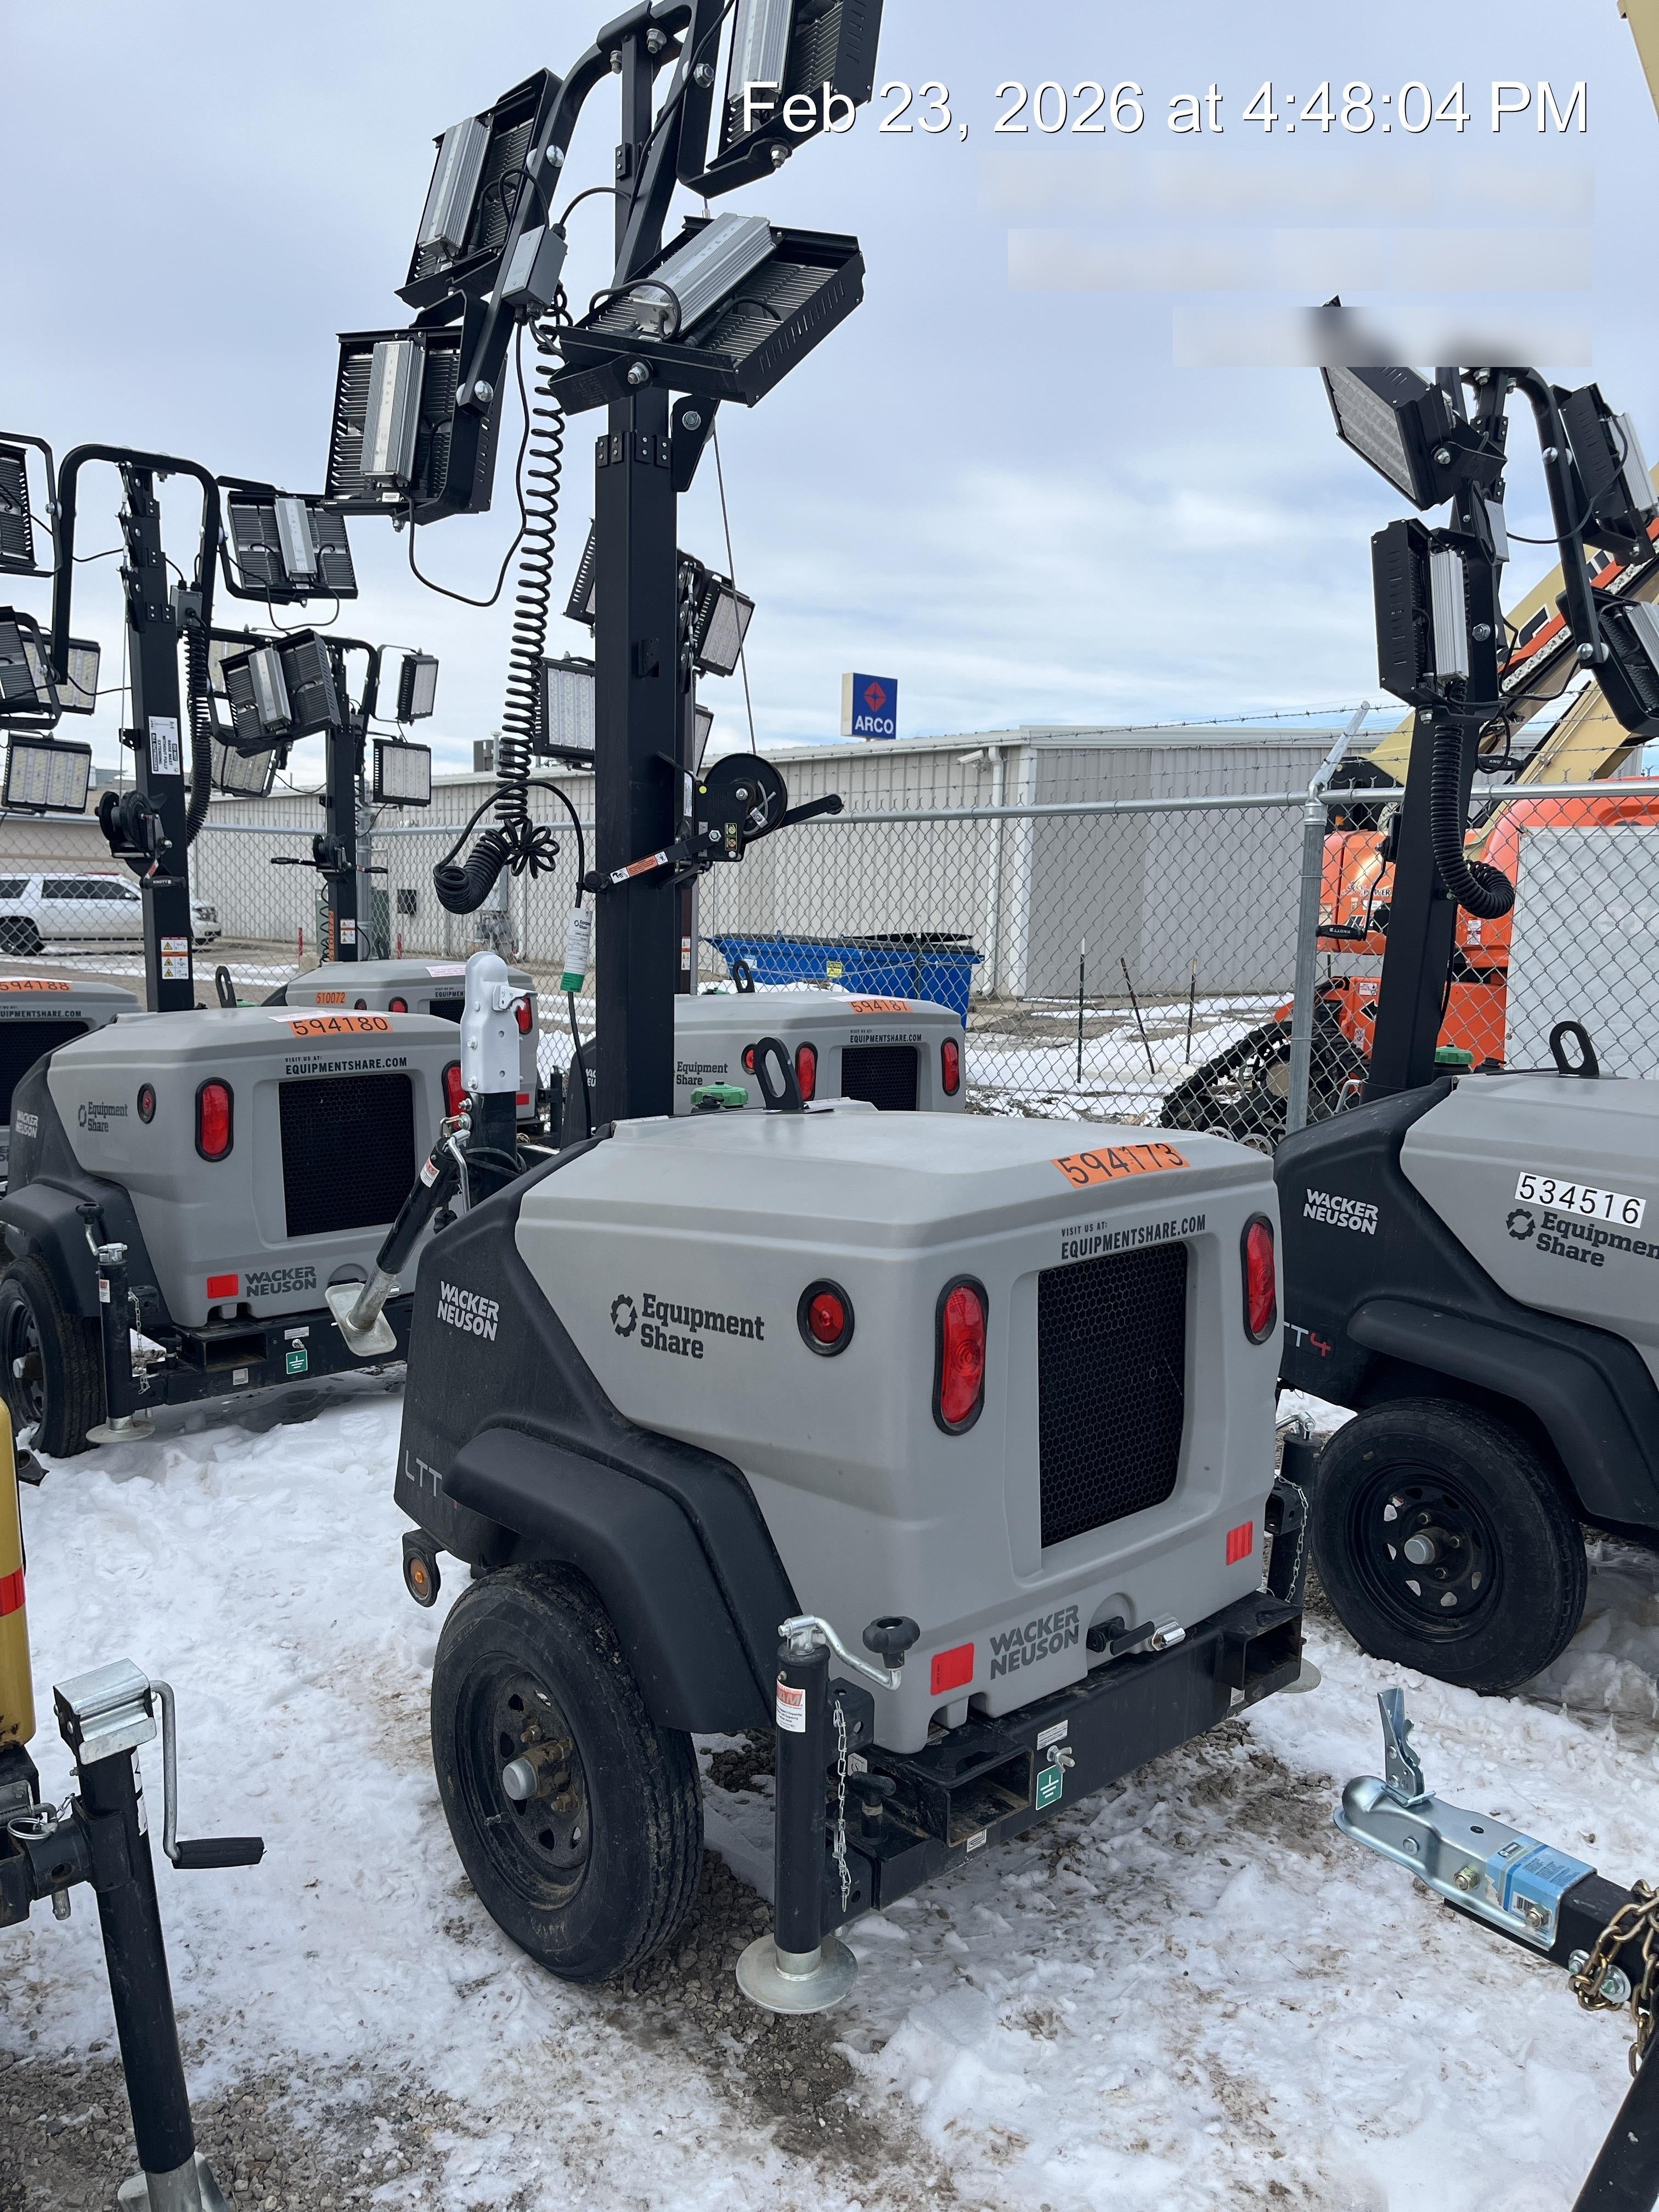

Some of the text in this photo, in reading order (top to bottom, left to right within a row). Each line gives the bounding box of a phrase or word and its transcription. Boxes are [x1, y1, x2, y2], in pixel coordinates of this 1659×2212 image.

[855, 715, 894, 734] ARCO
[0, 981, 70, 991] 594188
[317, 993, 346, 1004] 510072
[851, 1000, 907, 1013] 594187
[294, 1017, 388, 1036] 594180
[850, 1034, 922, 1043] EQUIPMENTSHARE.COM
[286, 1057, 407, 1075] EQUIPMENTSHARE.COM
[676, 1061, 728, 1075] Equipment
[676, 1075, 703, 1085] Share
[88, 1102, 128, 1119] Equipment
[88, 1119, 109, 1132] Share
[1057, 1143, 1183, 1184] 594173
[1306, 1188, 1379, 1221] WACKER
[1519, 1175, 1640, 1224] 534516
[1303, 1203, 1377, 1235] NEUSON
[1062, 1221, 1108, 1237] VISIT US AT:
[1062, 1214, 1206, 1260] EQUIPMENTSHARE.COM
[1541, 1211, 1659, 1260] Equipmen
[1536, 1233, 1605, 1267] Share
[245, 1266, 317, 1285] WACKER
[247, 1278, 317, 1297] NEUSON
[441, 1280, 499, 1322] WACKER
[437, 1300, 498, 1341] NEUSON
[642, 1293, 764, 1341] Equipment
[641, 1323, 703, 1359] Share
[990, 1605, 1080, 1656] WACKER
[990, 1624, 1079, 1680] NEUSON
